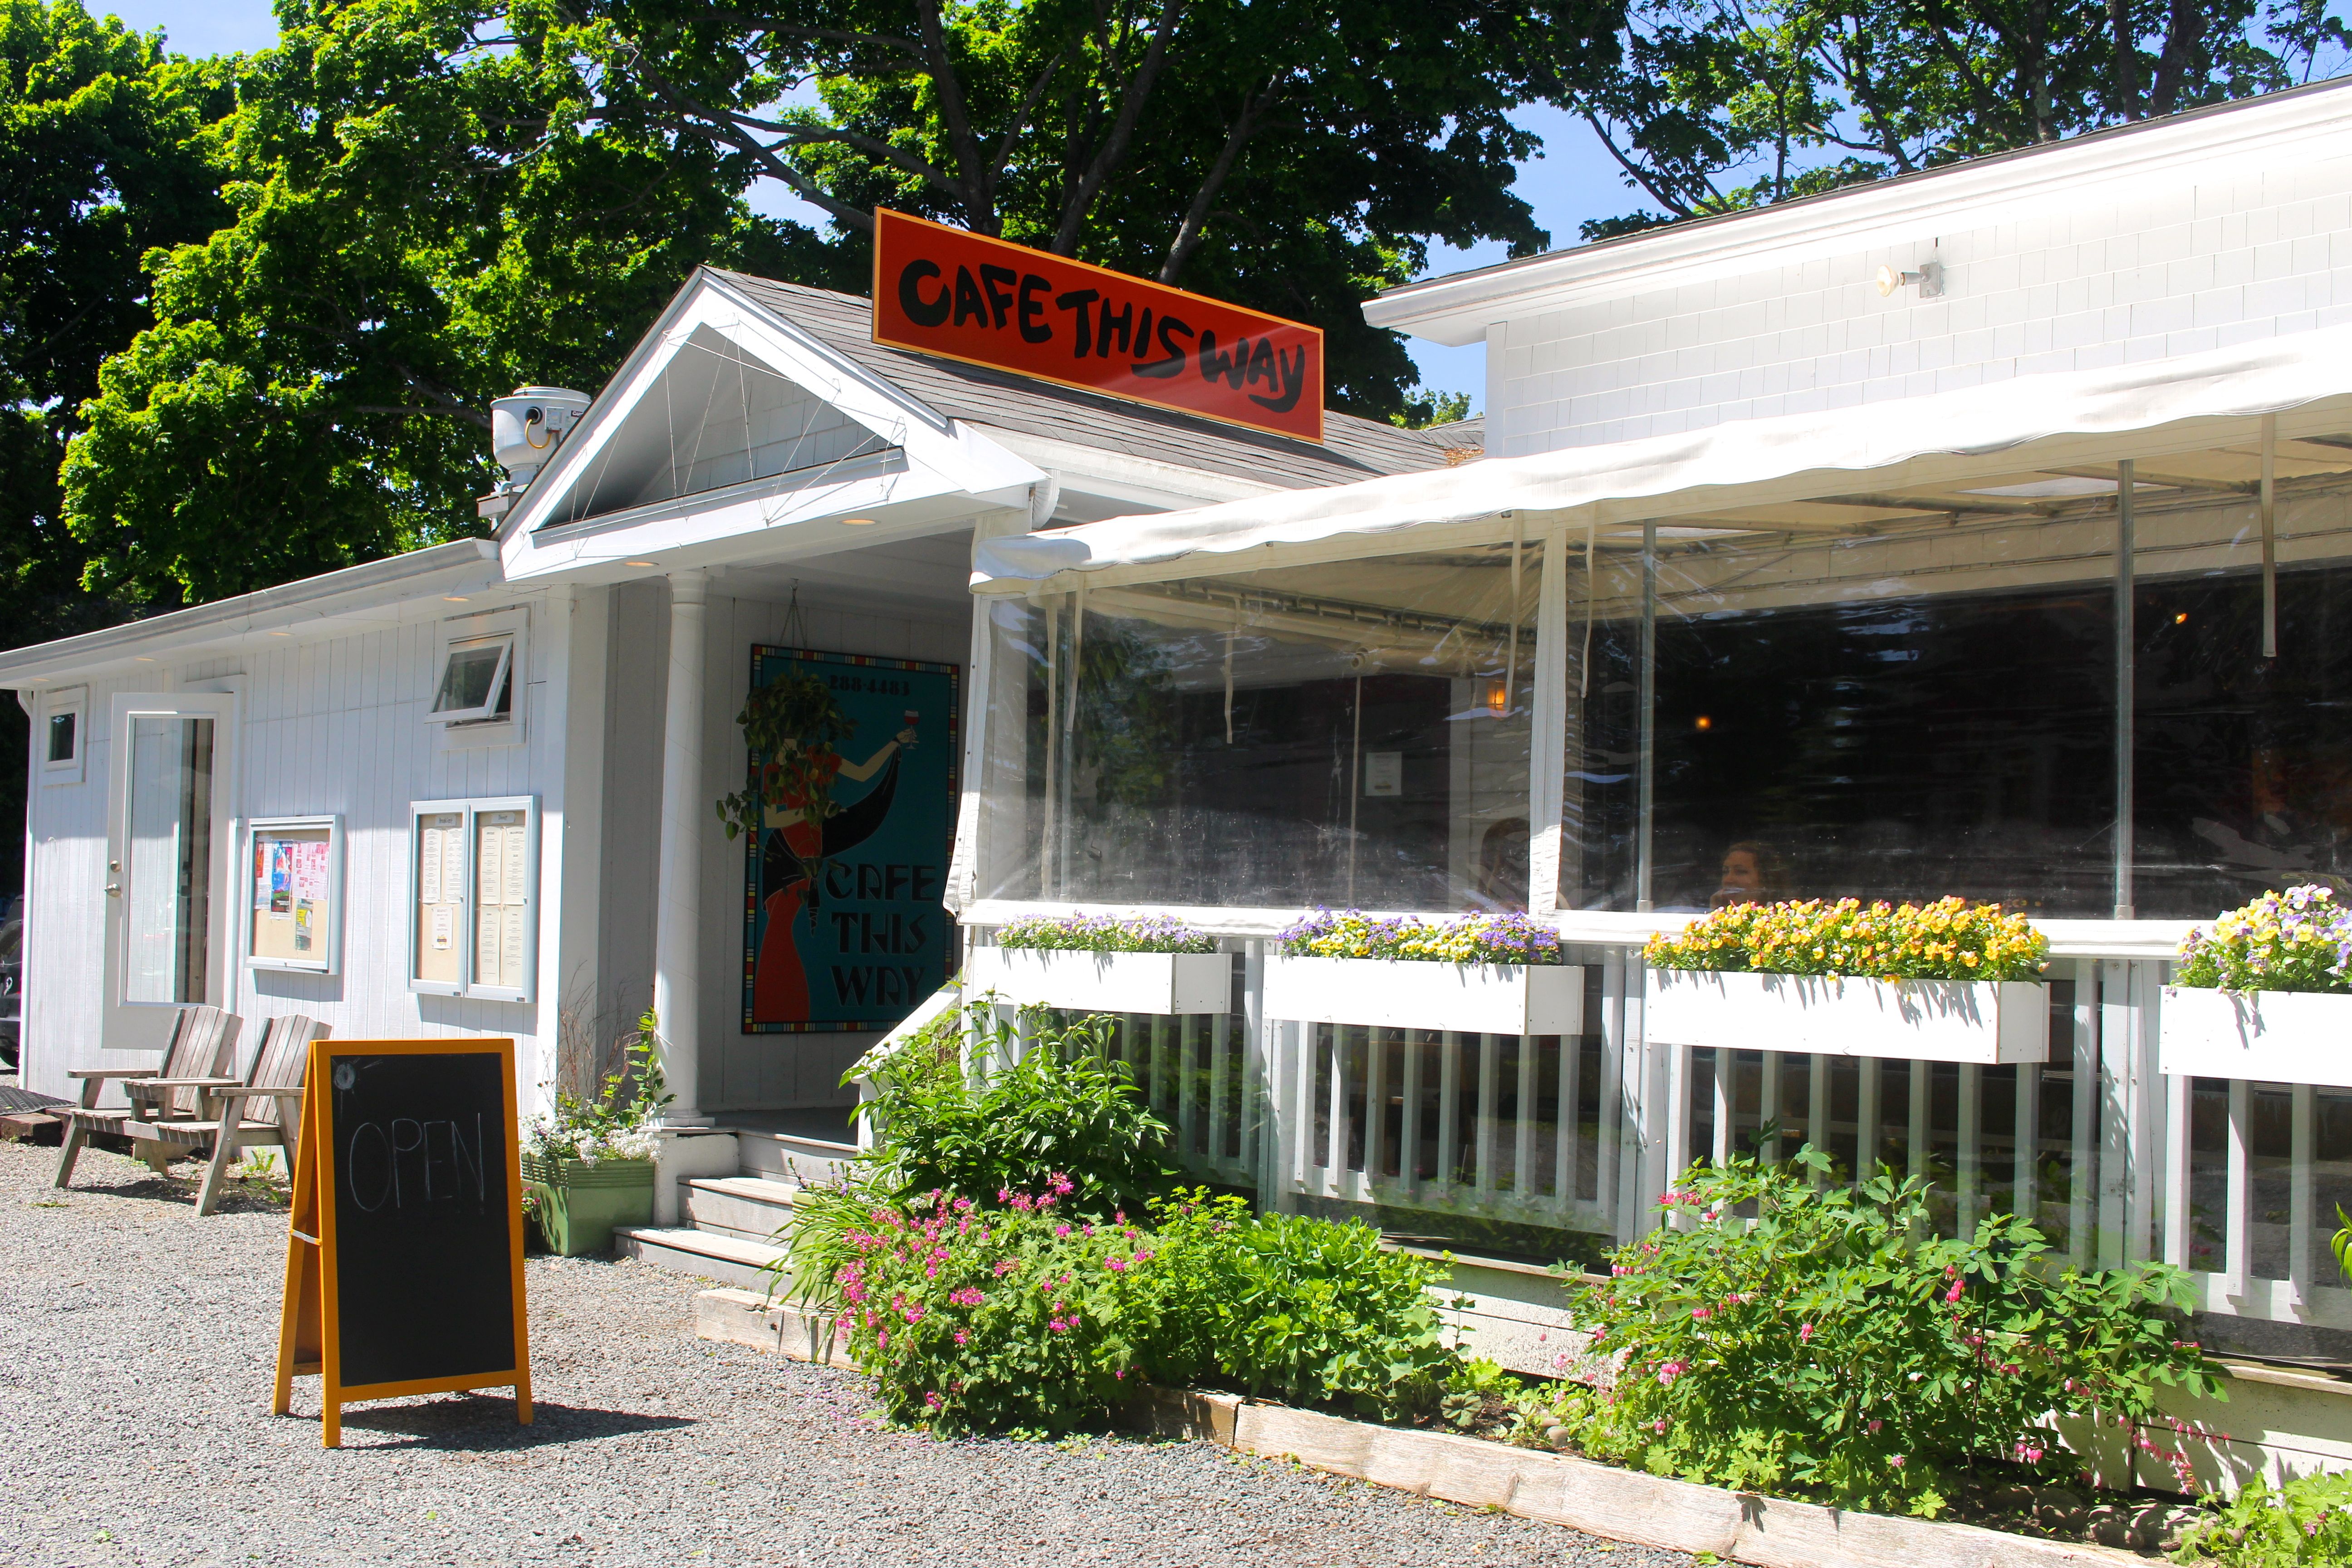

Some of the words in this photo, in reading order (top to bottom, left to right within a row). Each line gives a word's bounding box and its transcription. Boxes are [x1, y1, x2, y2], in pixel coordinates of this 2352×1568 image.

[898, 259, 1053, 343] CAFE
[1055, 289, 1194, 378] THIS
[1199, 329, 1305, 413] WAY
[825, 863, 936, 902] CAFE
[831, 912, 926, 955] THIS
[830, 965, 926, 1007] WAY
[350, 1113, 484, 1212] OPEN
